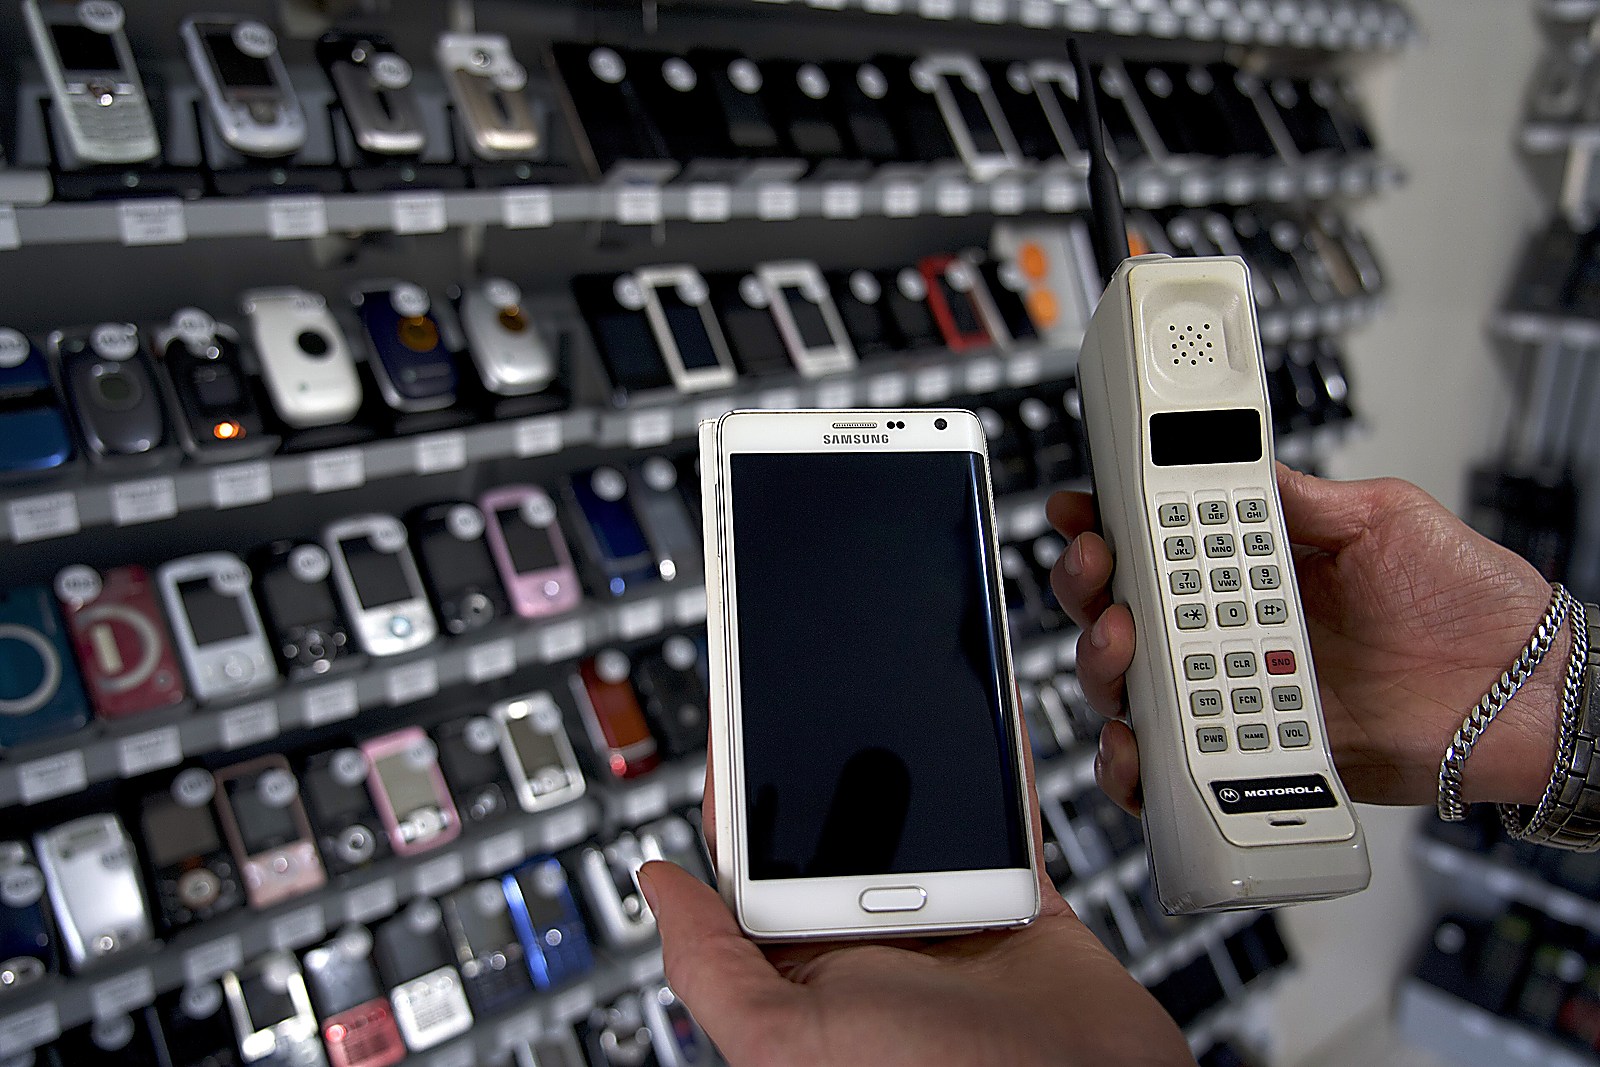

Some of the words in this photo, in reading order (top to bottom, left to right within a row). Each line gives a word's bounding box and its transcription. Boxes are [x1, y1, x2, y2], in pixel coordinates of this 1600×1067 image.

[823, 434, 889, 444] SAMSUNG
[1172, 506, 1178, 514] 1
[1211, 504, 1219, 512] 2
[1249, 502, 1256, 511] 3
[1177, 539, 1184, 547] 4
[1217, 537, 1224, 545] 5
[1255, 535, 1263, 543] 6
[1182, 573, 1190, 581] 7
[1223, 571, 1230, 579] 8
[1262, 569, 1269, 577] 9
[1193, 662, 1210, 670] RCL
[1234, 660, 1250, 668] CLR
[1200, 698, 1216, 706] STO
[1239, 696, 1256, 704] FCN
[1279, 694, 1297, 702] END
[1245, 787, 1323, 797] MOTOROLA
